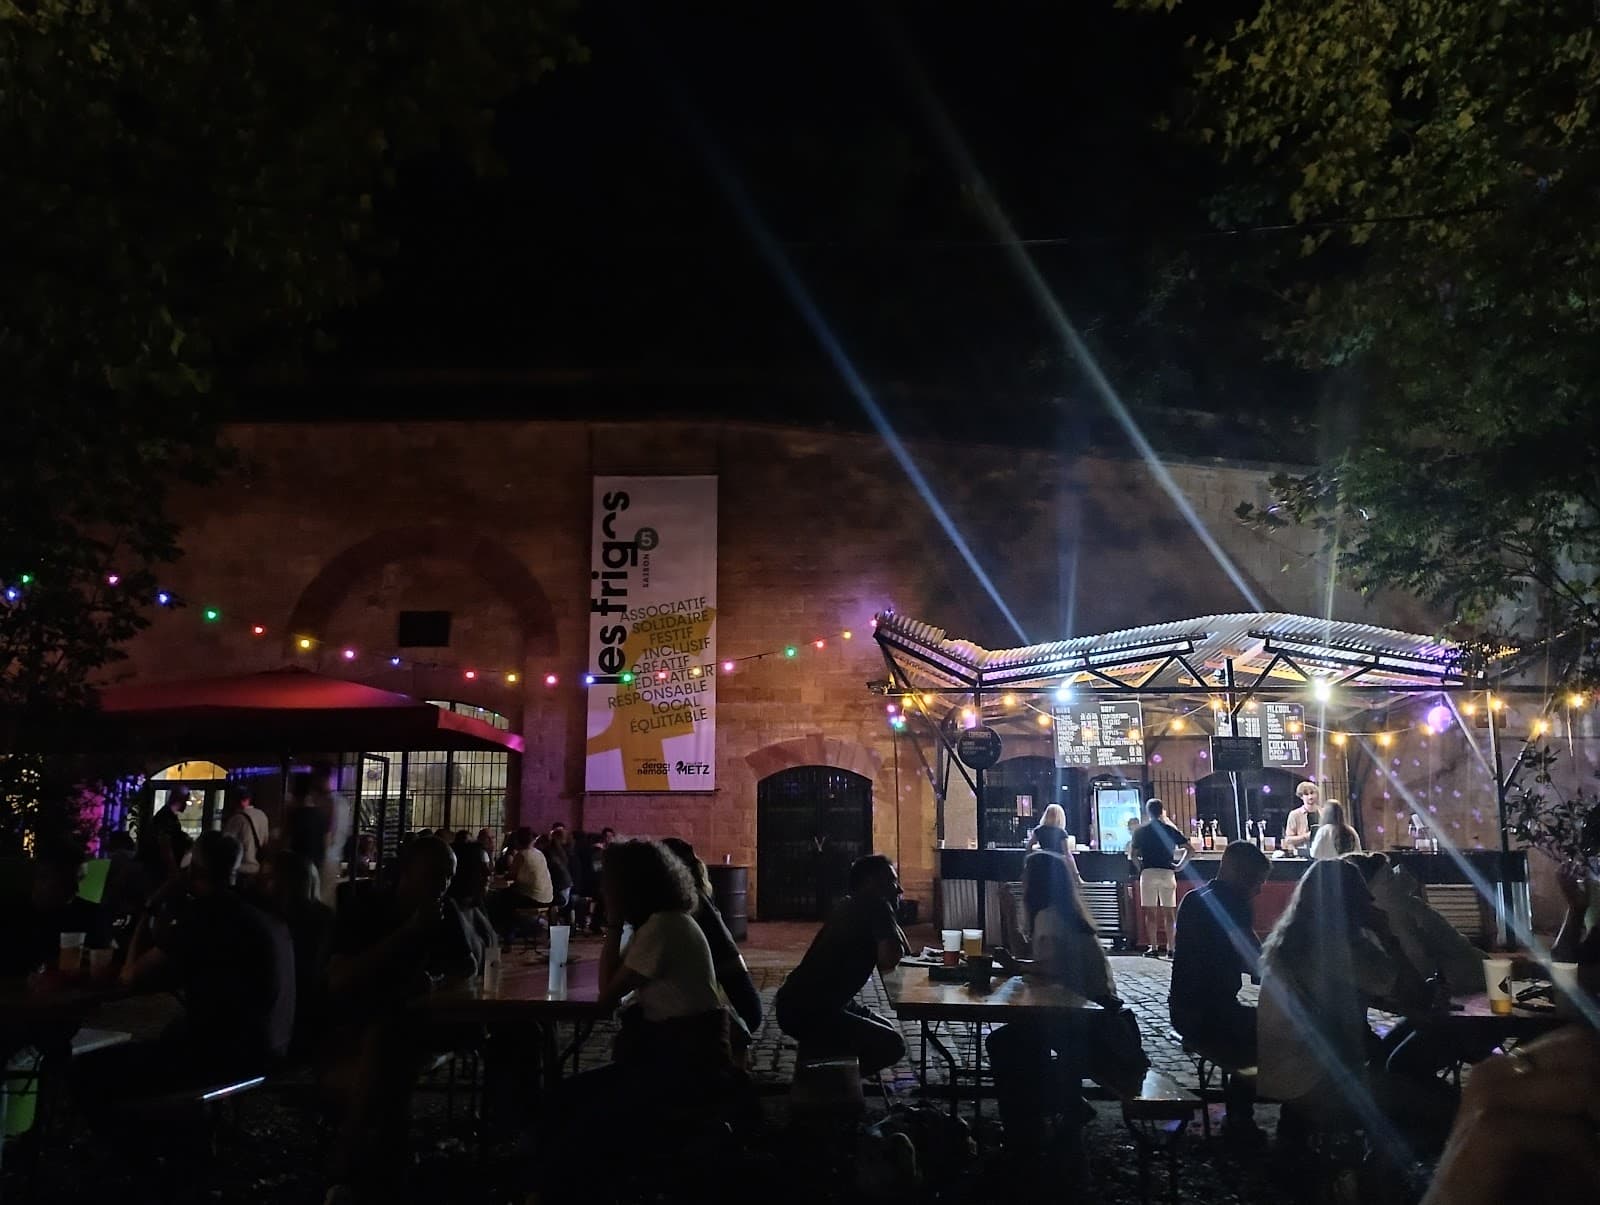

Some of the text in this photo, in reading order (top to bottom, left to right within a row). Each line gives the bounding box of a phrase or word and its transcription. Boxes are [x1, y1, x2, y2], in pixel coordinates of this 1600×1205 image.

[620, 597, 706, 622] ASSOCIATIF
[631, 610, 710, 634] SOLIDAIRE
[650, 626, 694, 645] FESTIF
[643, 637, 711, 660] INCLUSIF
[608, 680, 708, 709] RESPONSABLE
[651, 696, 701, 715] LOCAL
[630, 708, 708, 734] ÉQUITABLE
[677, 762, 710, 776] METZ
